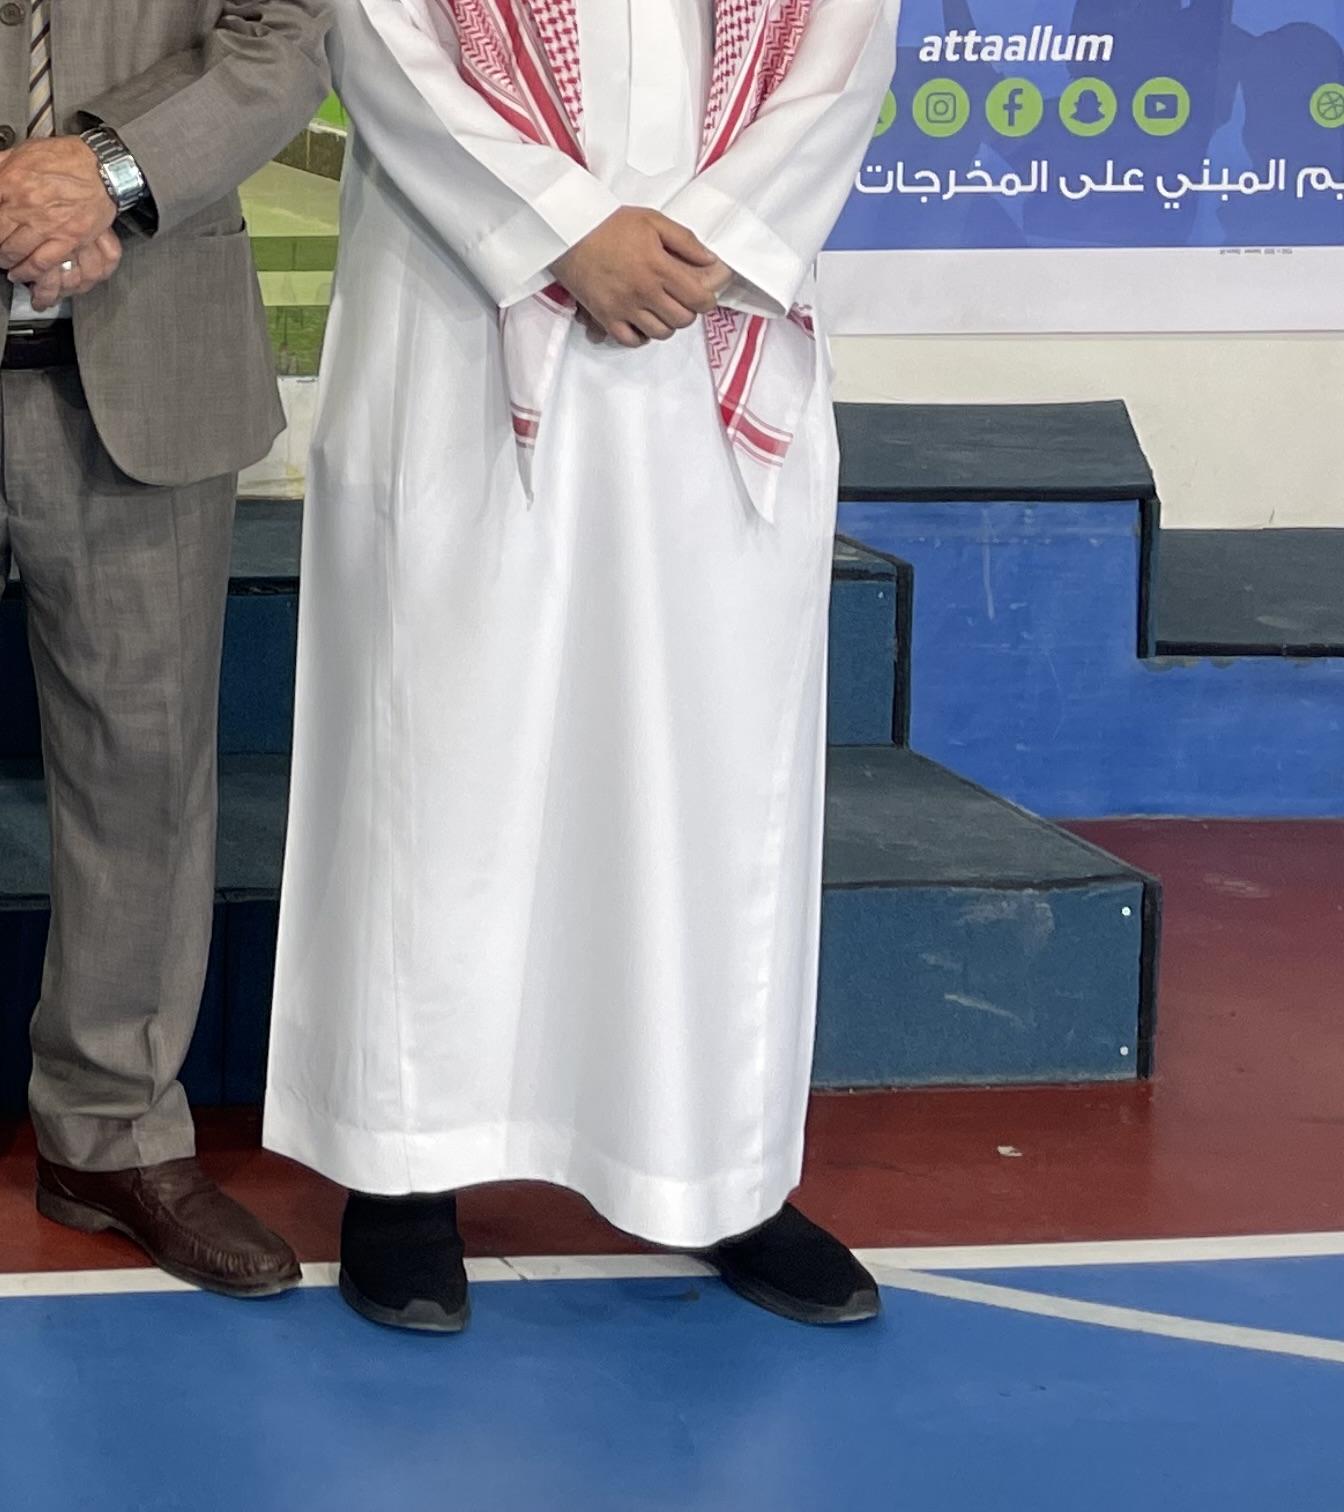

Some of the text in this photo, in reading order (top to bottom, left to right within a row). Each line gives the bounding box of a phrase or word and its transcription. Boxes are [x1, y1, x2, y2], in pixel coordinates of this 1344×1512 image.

[919, 25, 1114, 62] attaallum
[855, 160, 1048, 203] المخرجات
[1059, 160, 1144, 200] على
[1156, 159, 1286, 208] المبني
